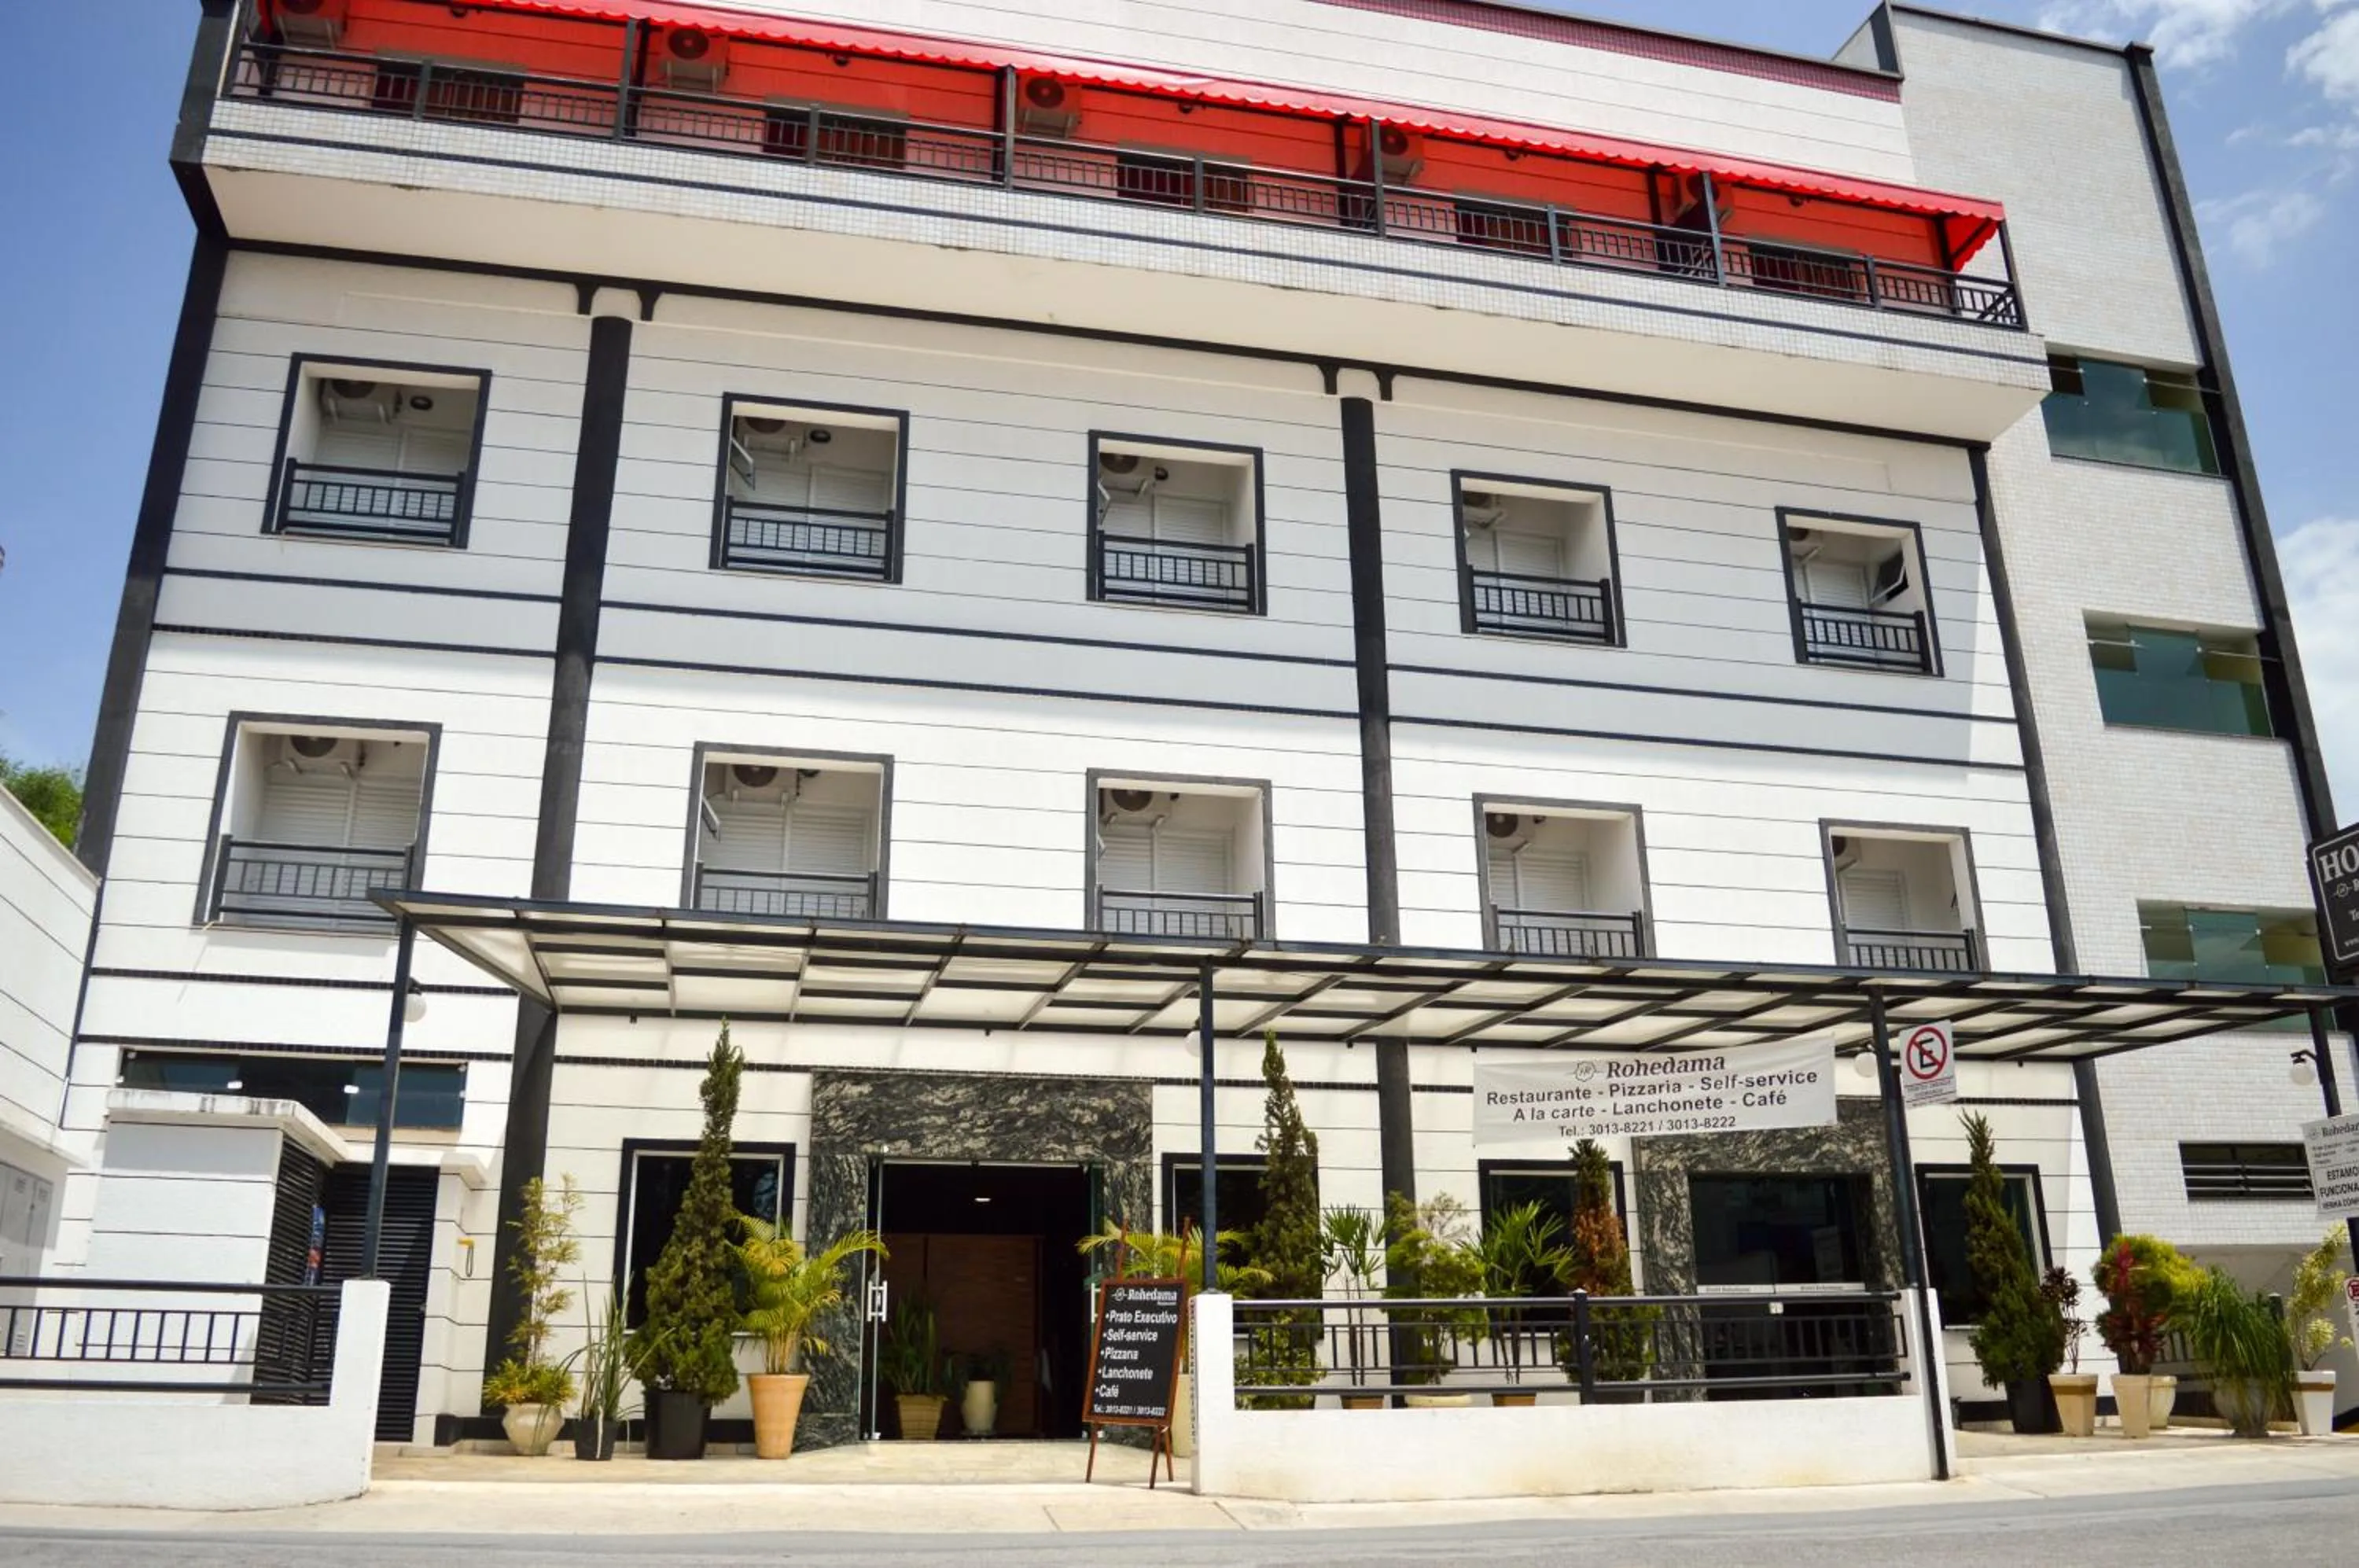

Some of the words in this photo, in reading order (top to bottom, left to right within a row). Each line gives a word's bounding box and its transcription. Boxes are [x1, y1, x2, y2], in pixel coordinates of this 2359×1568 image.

[2319, 842, 2359, 883] HO
[1606, 1056, 1725, 1079] Rohedama
[1486, 1086, 1592, 1106] Restaurante
[1609, 1080, 1682, 1098] Pizzaria
[1700, 1070, 1817, 1091] Self-service
[1513, 1108, 1525, 1122] A
[1530, 1107, 1546, 1121] la
[1551, 1106, 1595, 1120] carte
[1613, 1095, 1723, 1116] Lanchonete
[1742, 1089, 1787, 1107] Café
[1560, 1125, 1584, 1138] Tel.:
[1588, 1121, 1654, 1136] 3013-8221
[1667, 1116, 1736, 1131] 3013-8222
[1109, 1309, 1133, 1323] Prato
[1134, 1310, 1178, 1324] Executivo
[1106, 1328, 1158, 1342] Self-service
[1102, 1365, 1154, 1380] Lanchonete
[1099, 1384, 1119, 1397] Café
